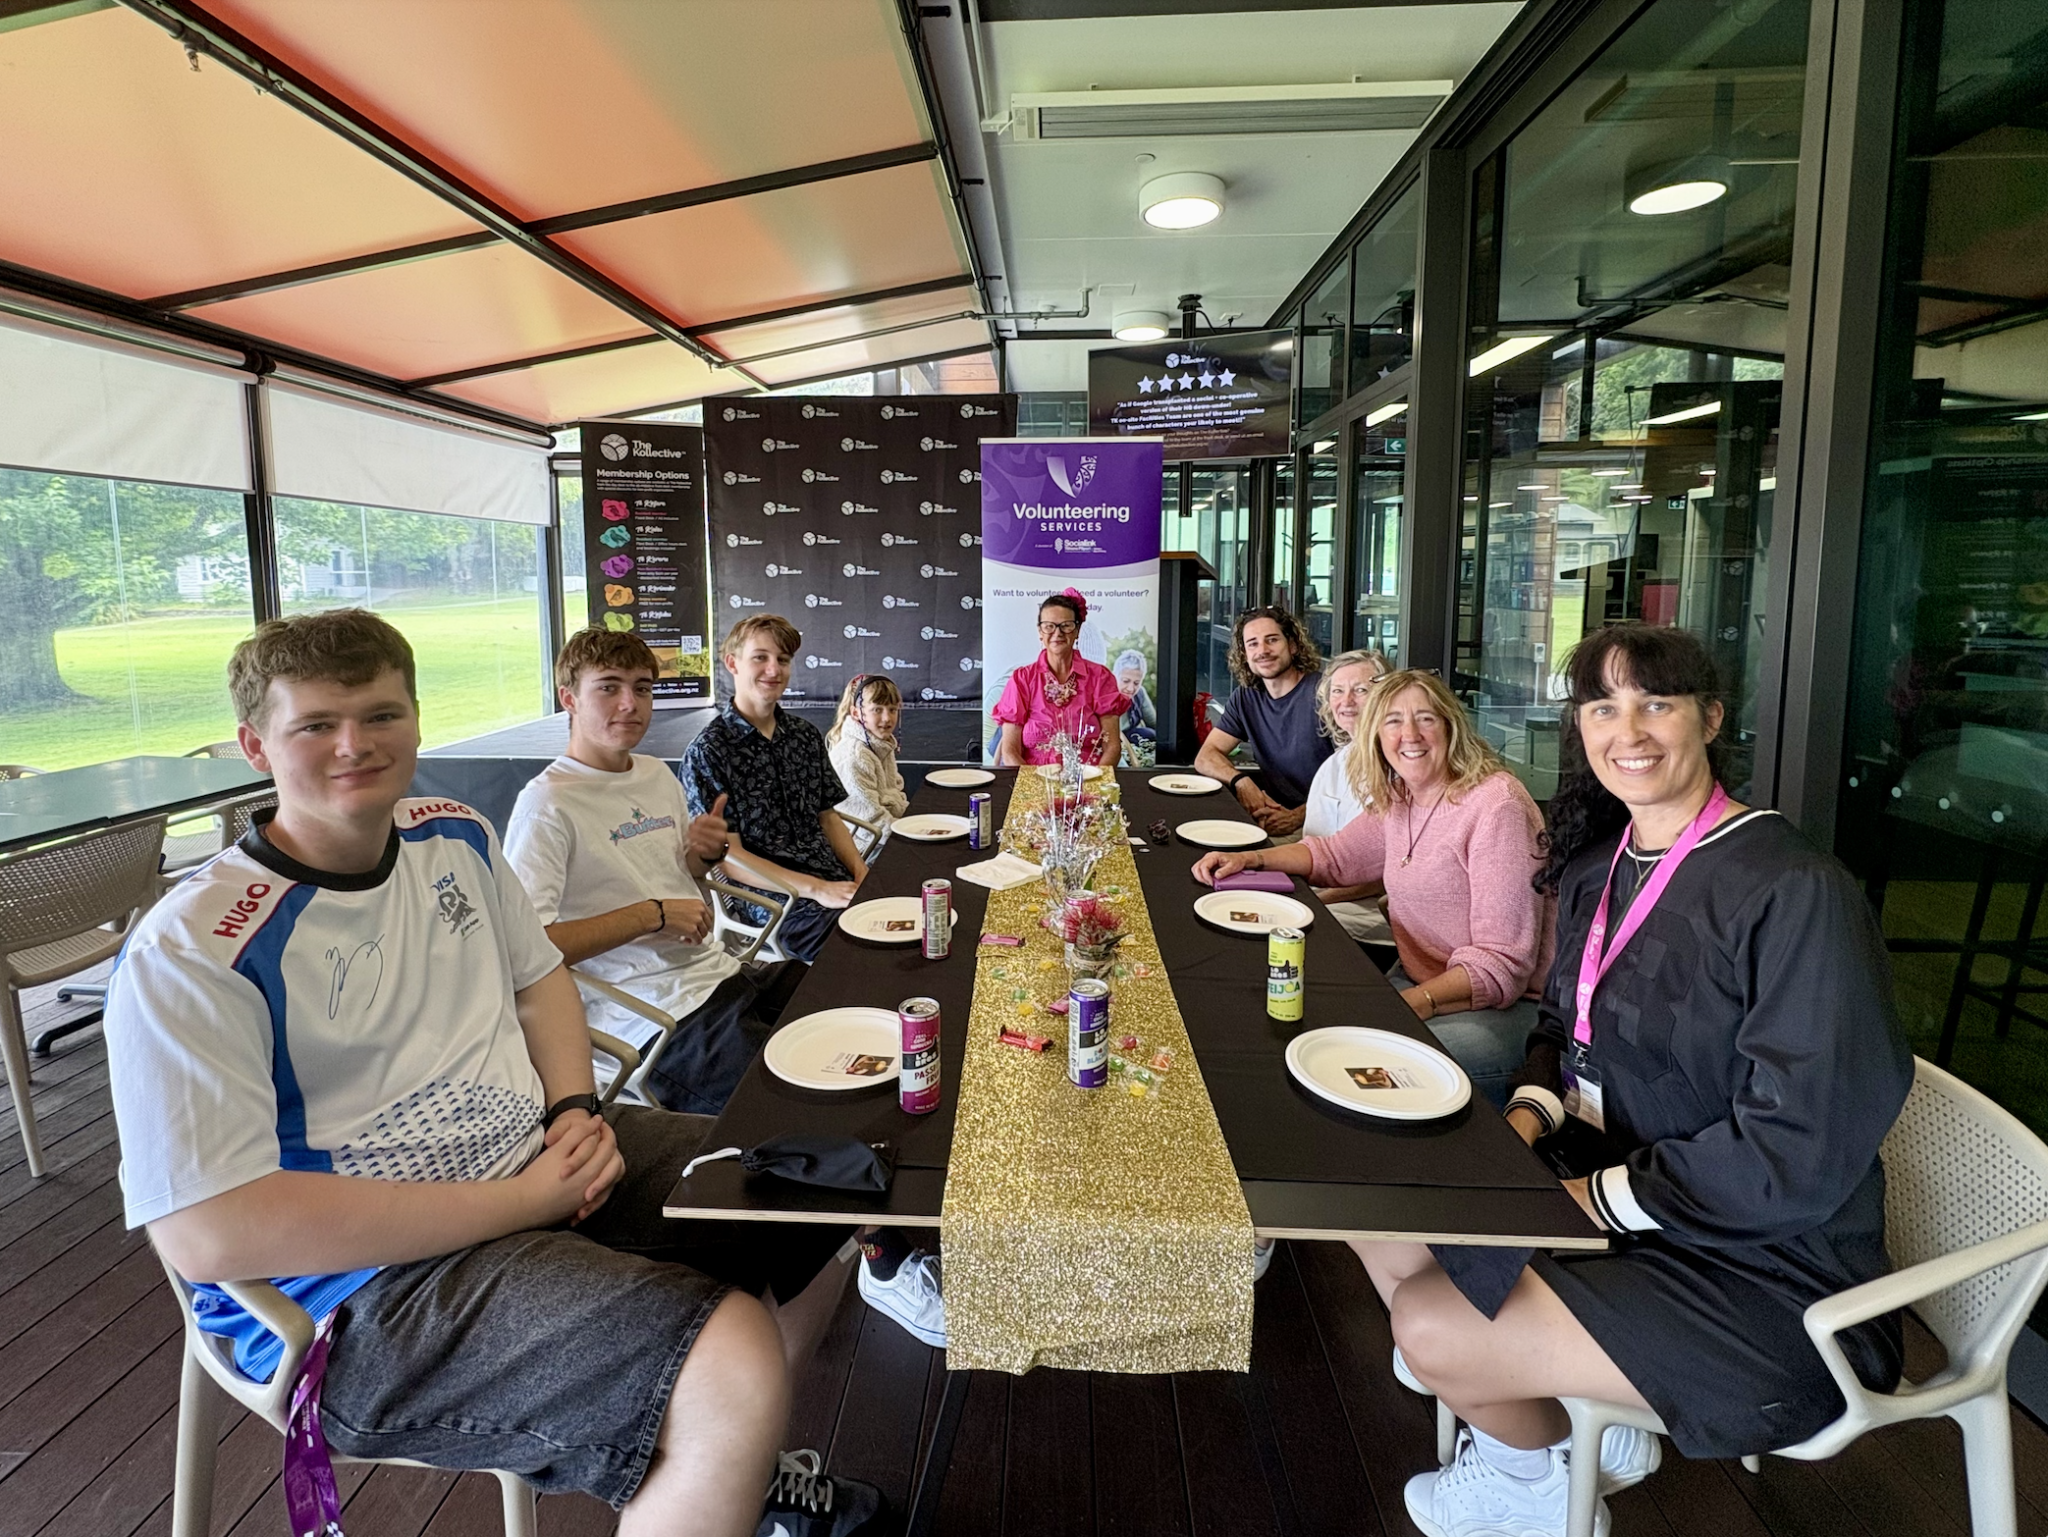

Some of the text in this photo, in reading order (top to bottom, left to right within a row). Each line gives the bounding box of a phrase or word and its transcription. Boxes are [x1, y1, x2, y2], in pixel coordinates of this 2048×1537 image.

[632, 440, 652, 449] The
[597, 469, 689, 480] Membership Options
[1013, 503, 1130, 522] Volunteering
[1040, 522, 1102, 532] SERVICES
[409, 802, 472, 820] HUGO
[430, 872, 455, 892] VISA
[213, 882, 271, 939] HUGO
[915, 1051, 937, 1067] BROS
[916, 1052, 928, 1060] LO
